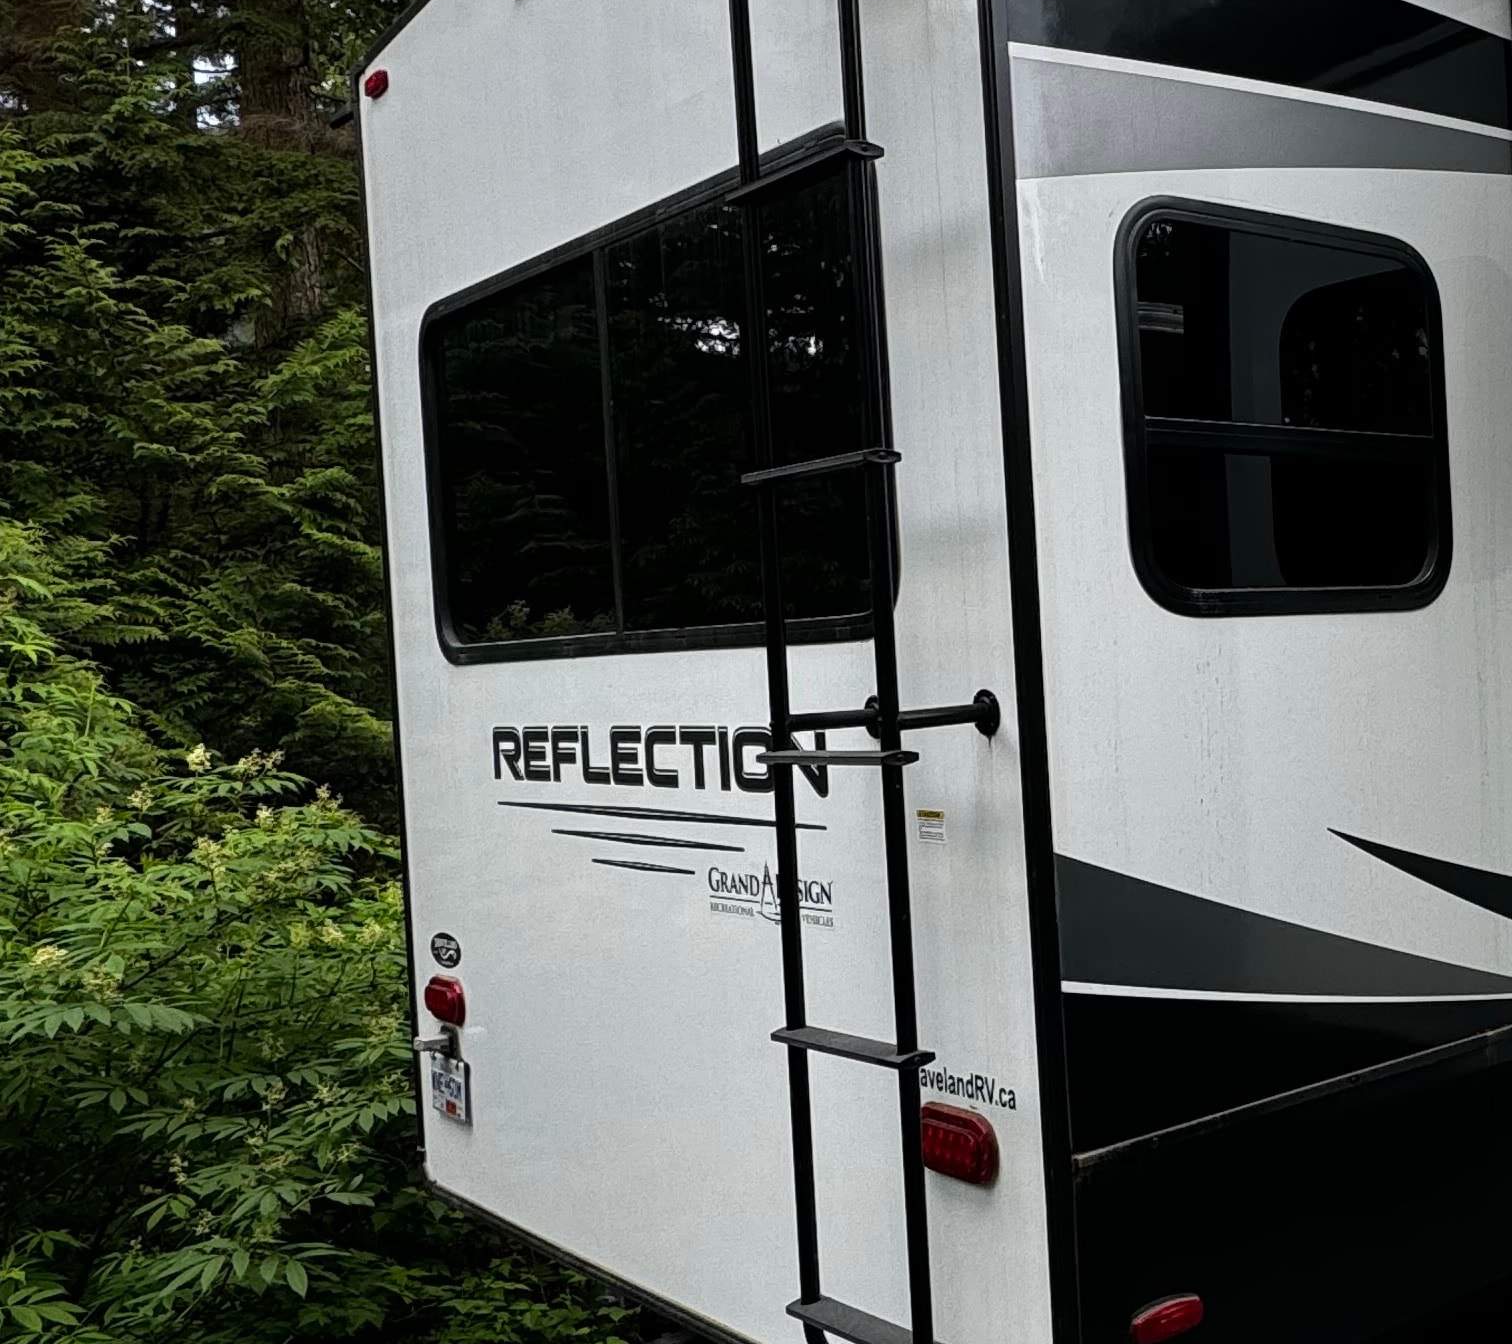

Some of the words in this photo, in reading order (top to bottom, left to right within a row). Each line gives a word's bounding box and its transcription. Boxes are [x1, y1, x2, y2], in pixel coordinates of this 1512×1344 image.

[492, 725, 829, 798] REFLECTION
[708, 866, 760, 897] GRAND
[776, 873, 833, 905] SIGN
[919, 1066, 1017, 1111] avelandRV.ca
